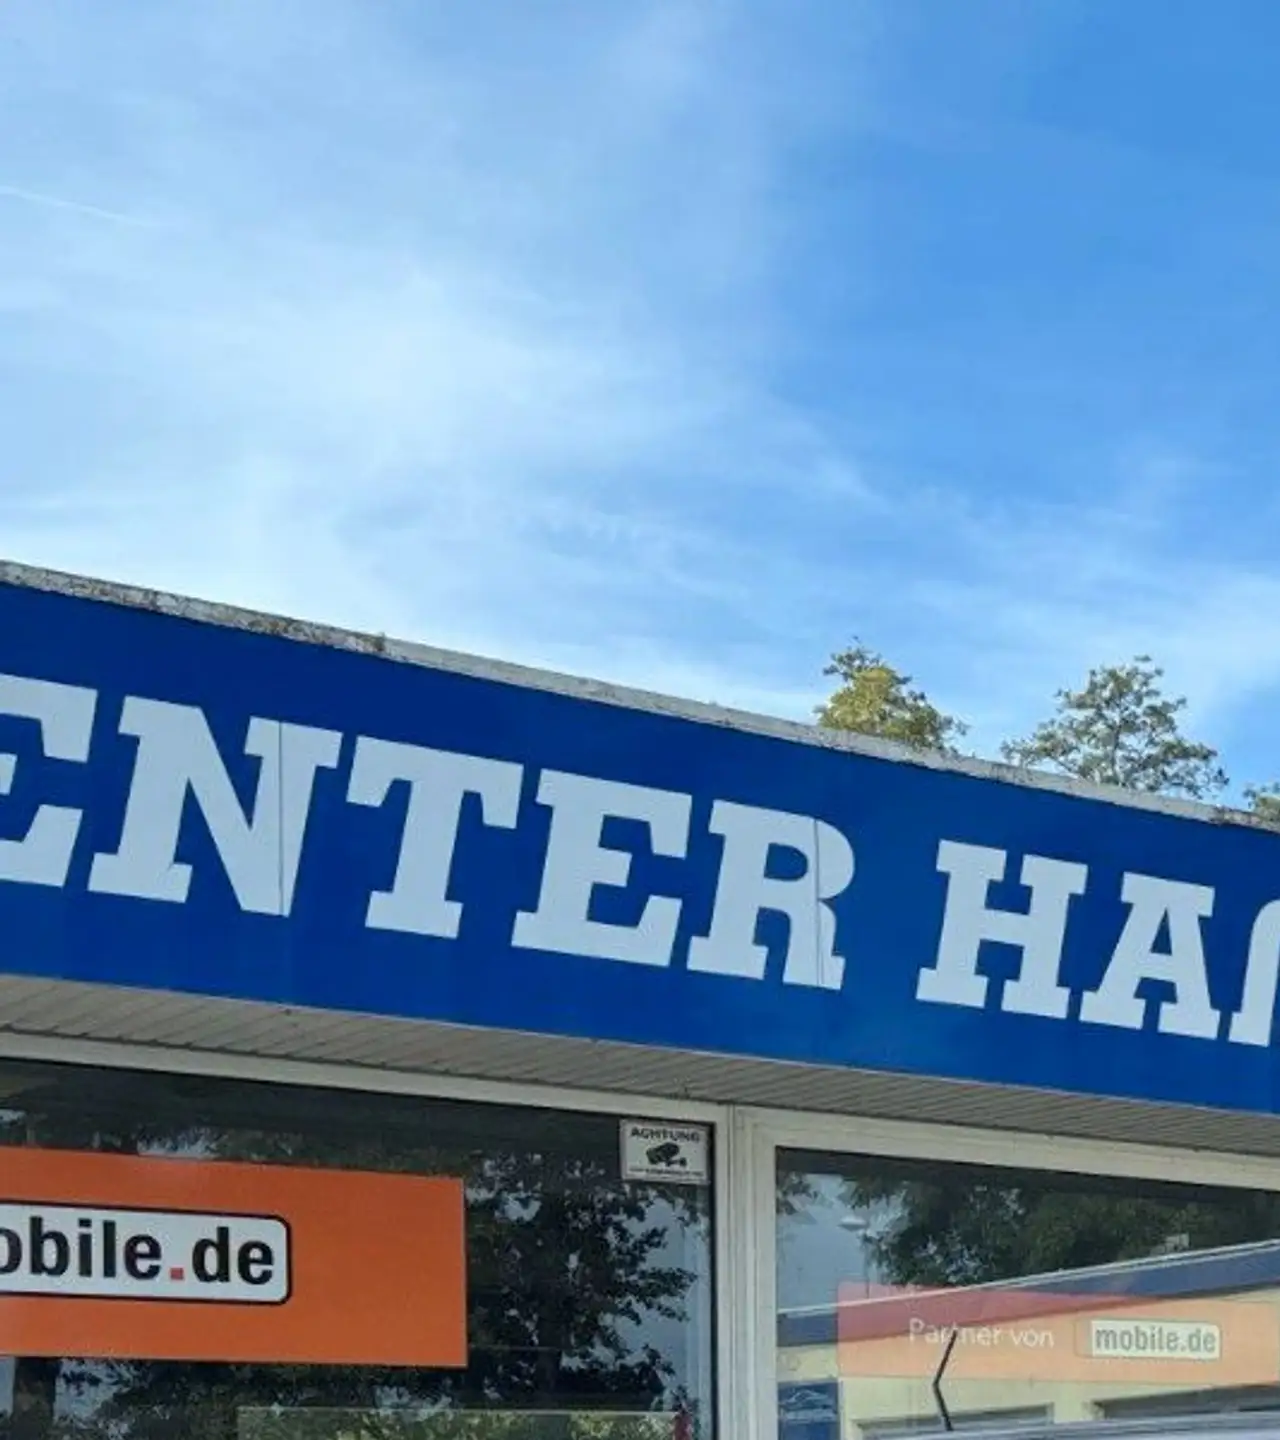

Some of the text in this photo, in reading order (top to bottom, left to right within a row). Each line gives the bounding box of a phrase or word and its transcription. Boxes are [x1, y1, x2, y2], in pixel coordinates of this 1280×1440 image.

[908, 1317, 1217, 1353] Partner von mobile.de
